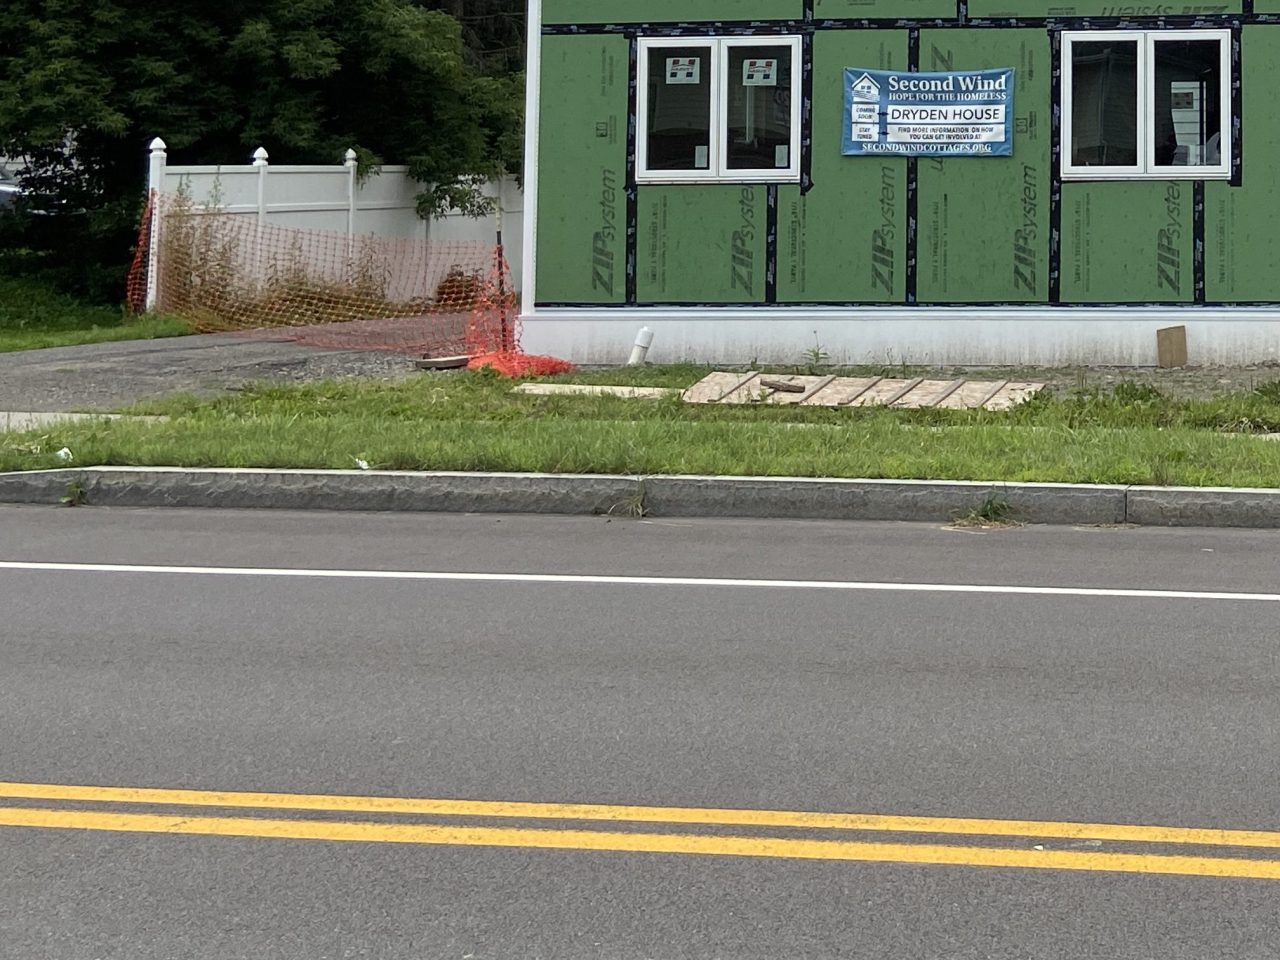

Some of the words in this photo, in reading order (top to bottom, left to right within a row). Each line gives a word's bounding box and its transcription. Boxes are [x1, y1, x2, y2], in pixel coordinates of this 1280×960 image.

[888, 75, 955, 91] Second
[957, 75, 1006, 91] Wind
[888, 92, 915, 101] HOPE
[916, 92, 935, 101] FOR
[936, 92, 955, 101] THE
[957, 91, 1007, 101] HOMELESS
[891, 109, 948, 121] DRYDEN
[953, 108, 1000, 121] HOUSE
[862, 142, 993, 153] SECONDWINDCOTTAGES.ORG
